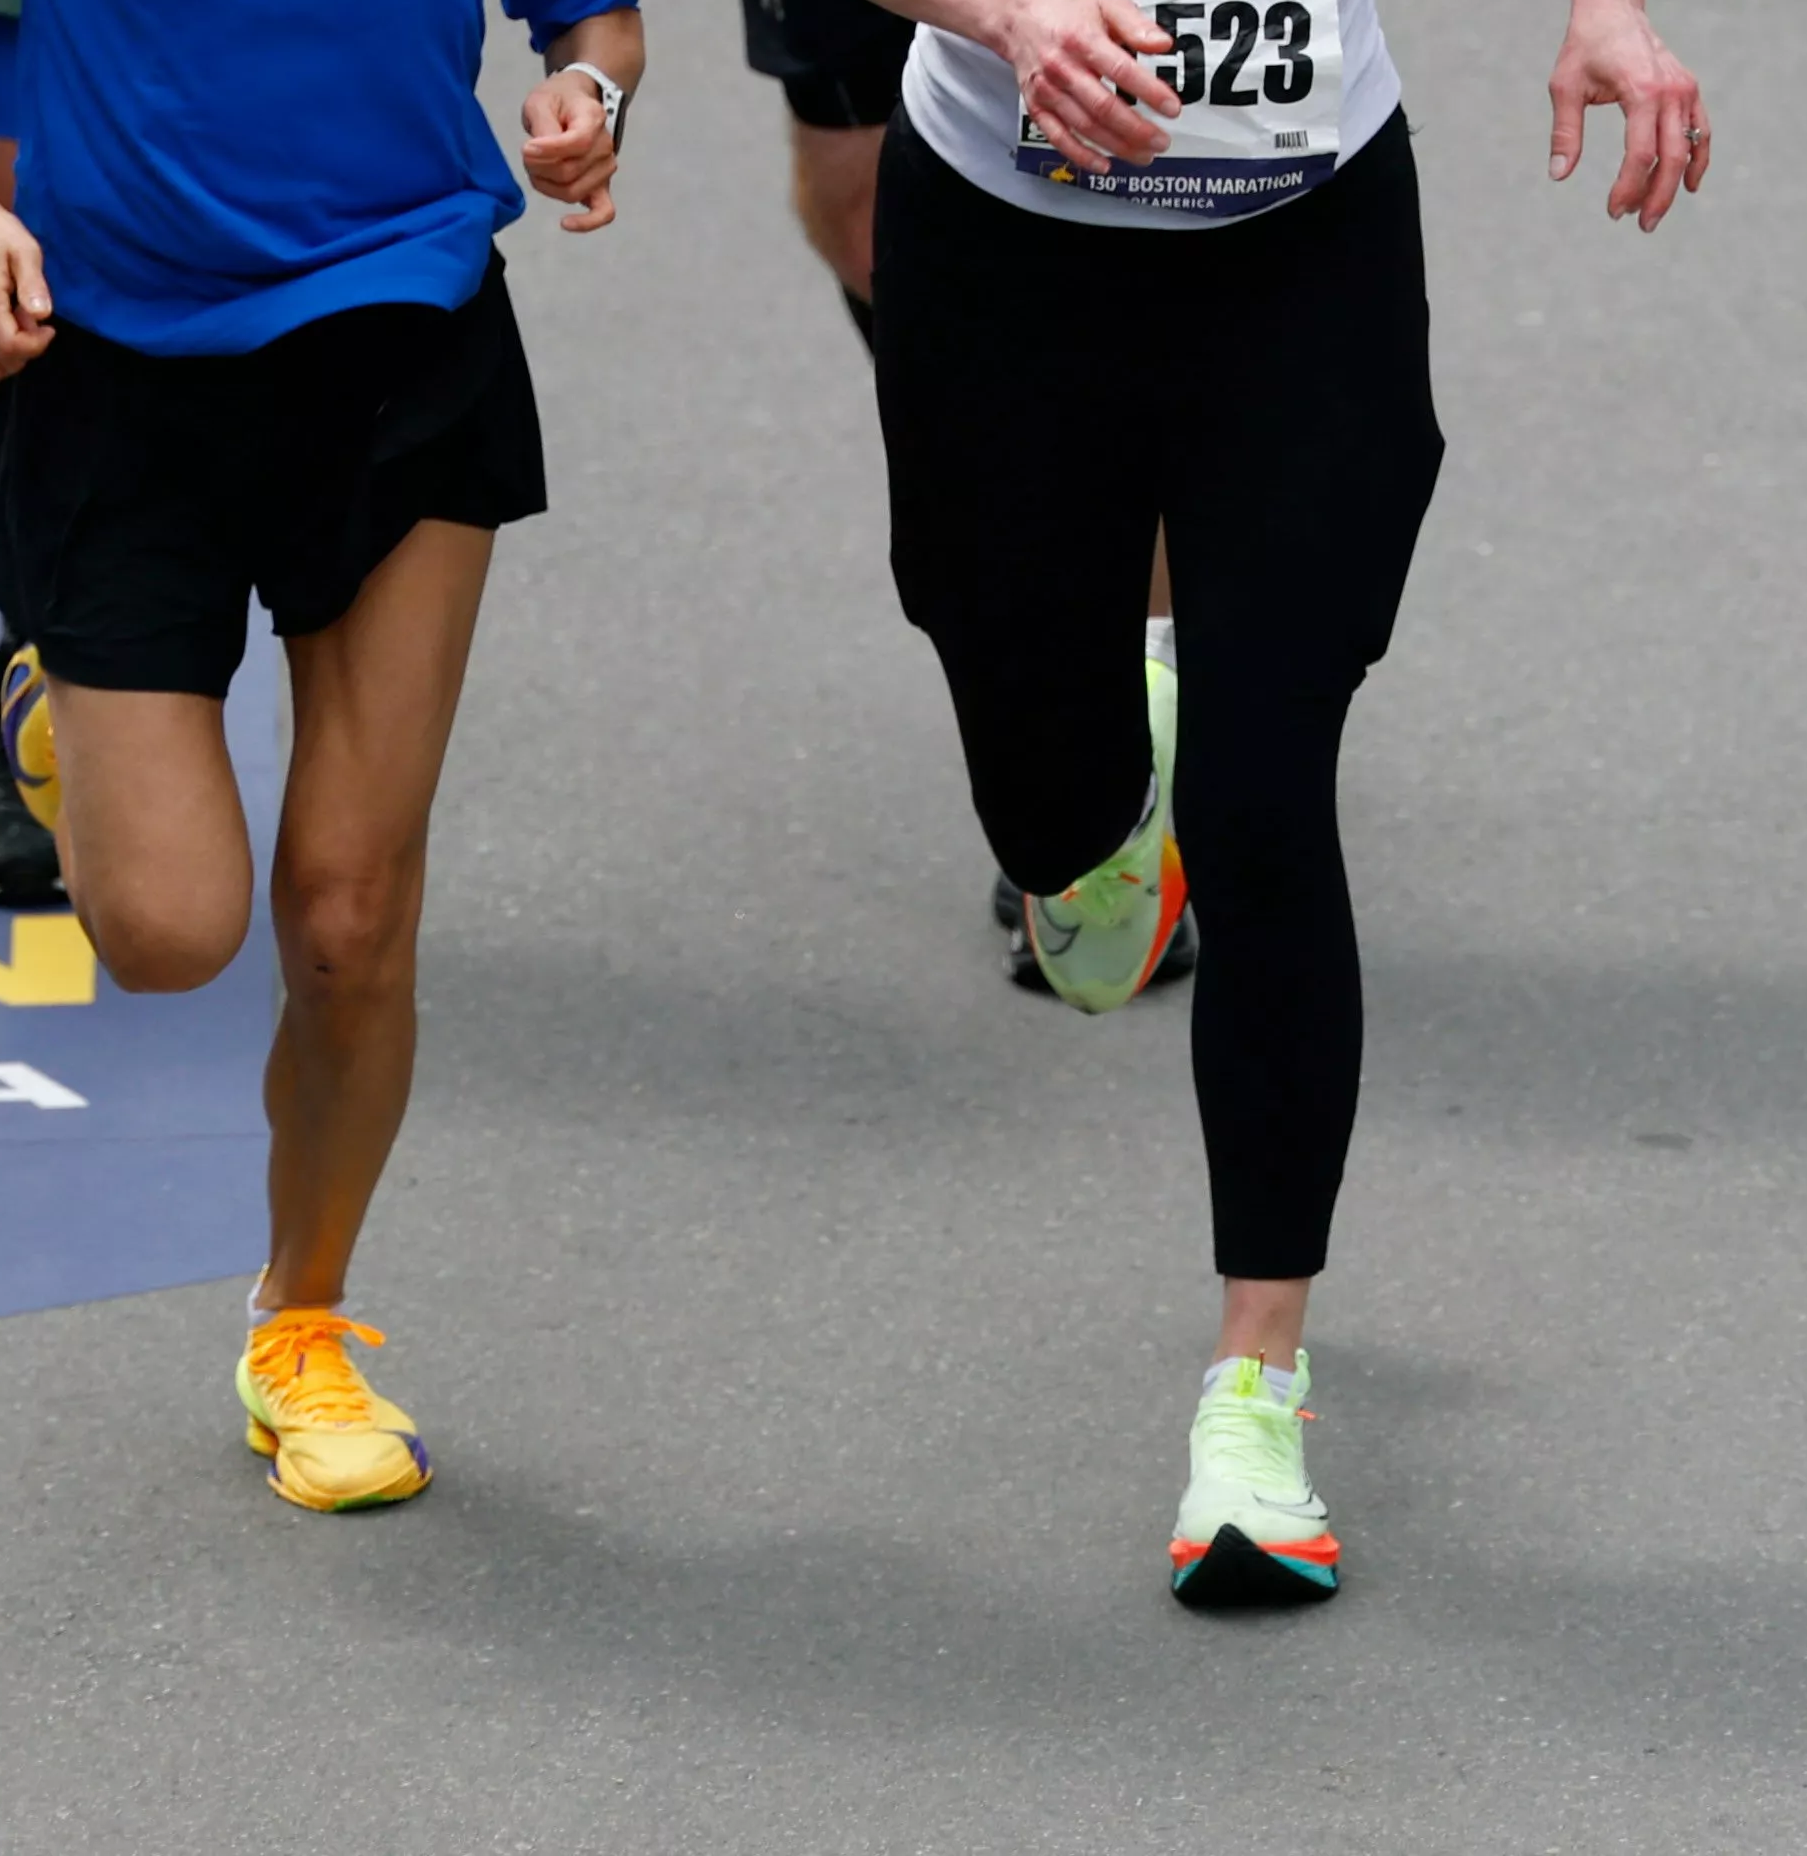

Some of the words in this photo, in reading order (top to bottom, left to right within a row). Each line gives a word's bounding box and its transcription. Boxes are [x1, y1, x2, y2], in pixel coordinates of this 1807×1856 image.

[1115, 0, 1314, 106] 523
[1128, 175, 1201, 194] BOSTON
[1206, 170, 1303, 195] MARATHON
[1151, 197, 1215, 209] AMERICA
